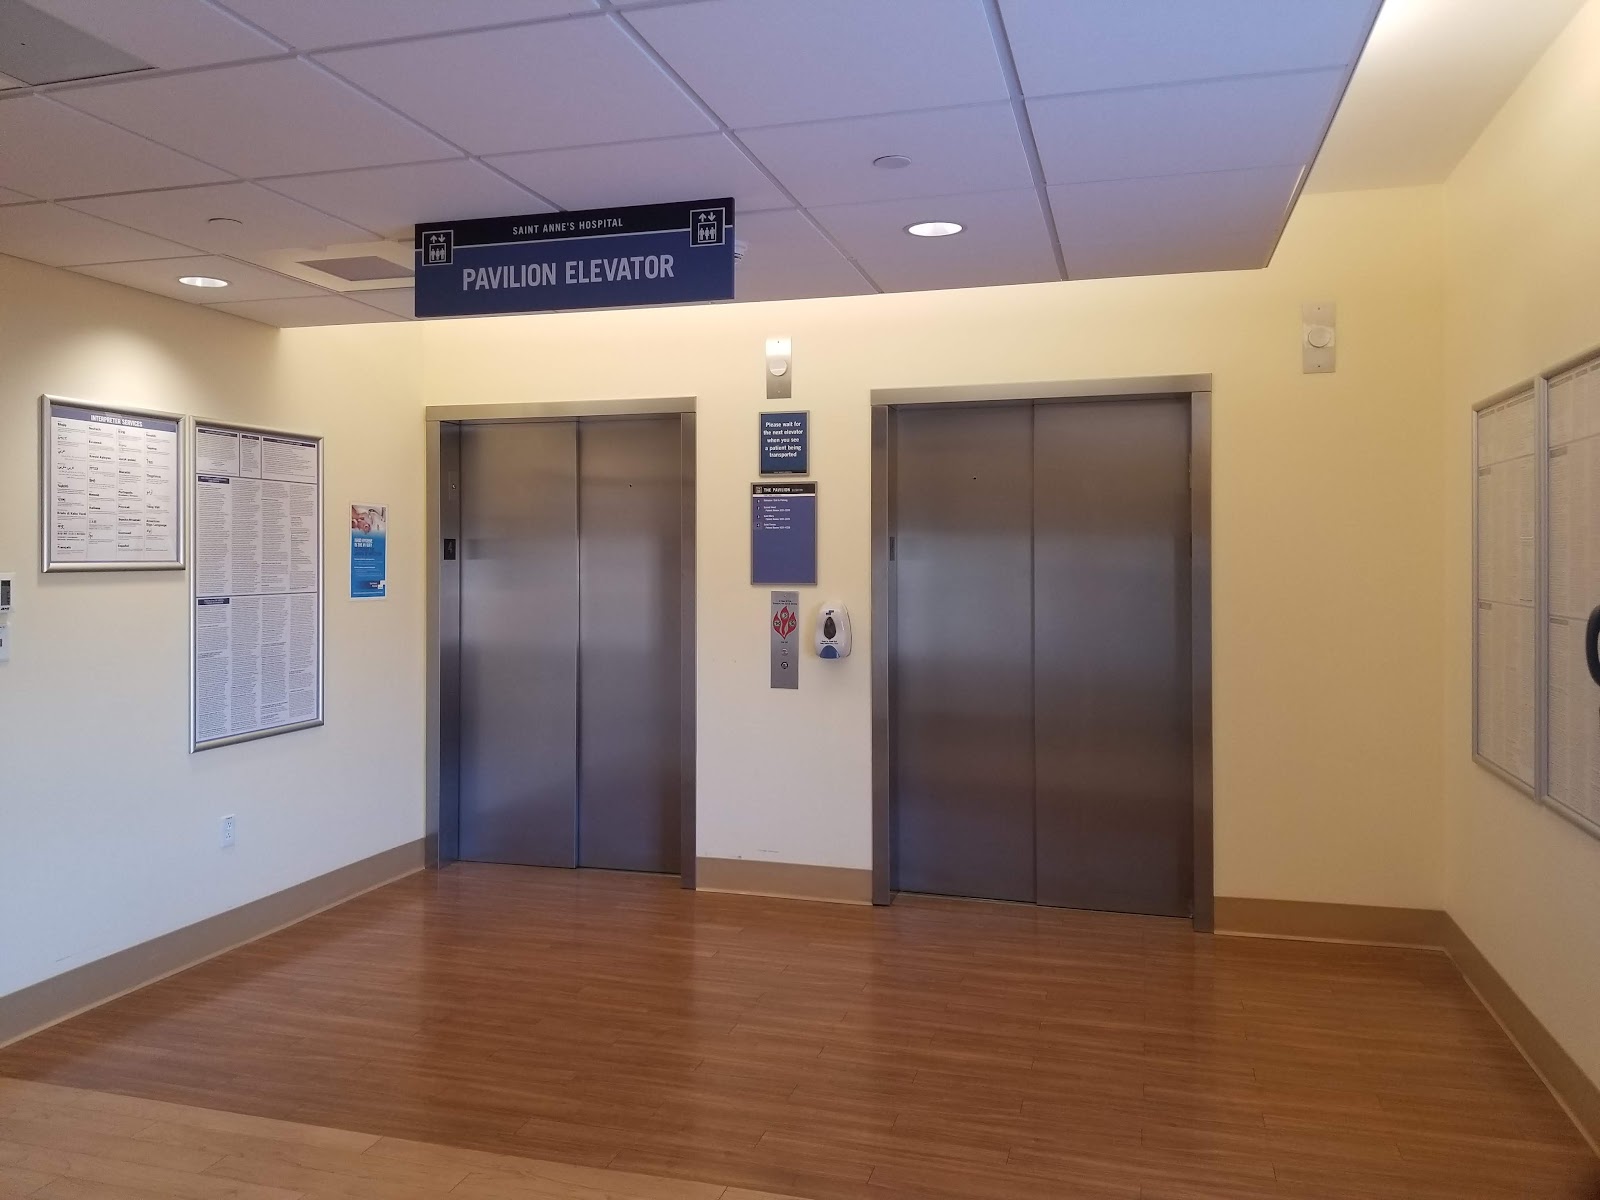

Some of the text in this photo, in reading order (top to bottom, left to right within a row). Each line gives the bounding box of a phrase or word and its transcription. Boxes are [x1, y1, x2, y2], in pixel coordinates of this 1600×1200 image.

[512, 218, 623, 235] SAINT ANNE'S HOSPITAL
[462, 254, 674, 291] PAVILION ELEVATOR
[90, 414, 143, 428] INTERPRETER SERVICES
